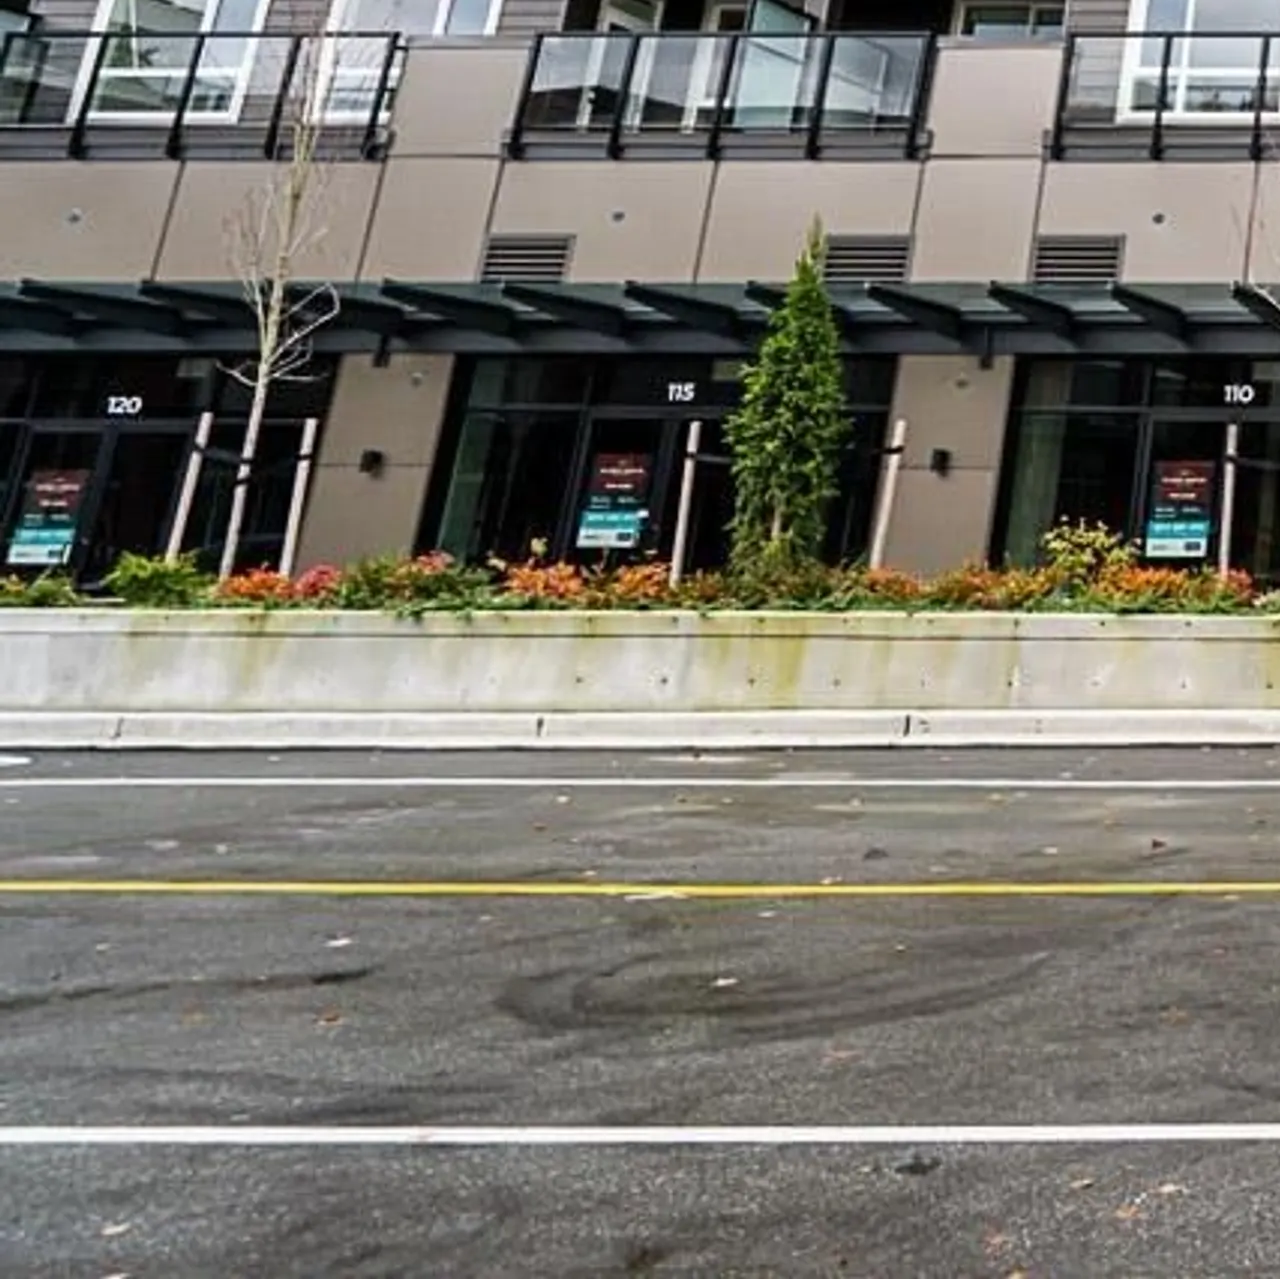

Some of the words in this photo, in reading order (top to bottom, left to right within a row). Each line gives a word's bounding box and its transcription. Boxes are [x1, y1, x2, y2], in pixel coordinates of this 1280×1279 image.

[668, 381, 695, 402] 115
[1224, 384, 1255, 404] 110
[107, 396, 143, 414] 120
